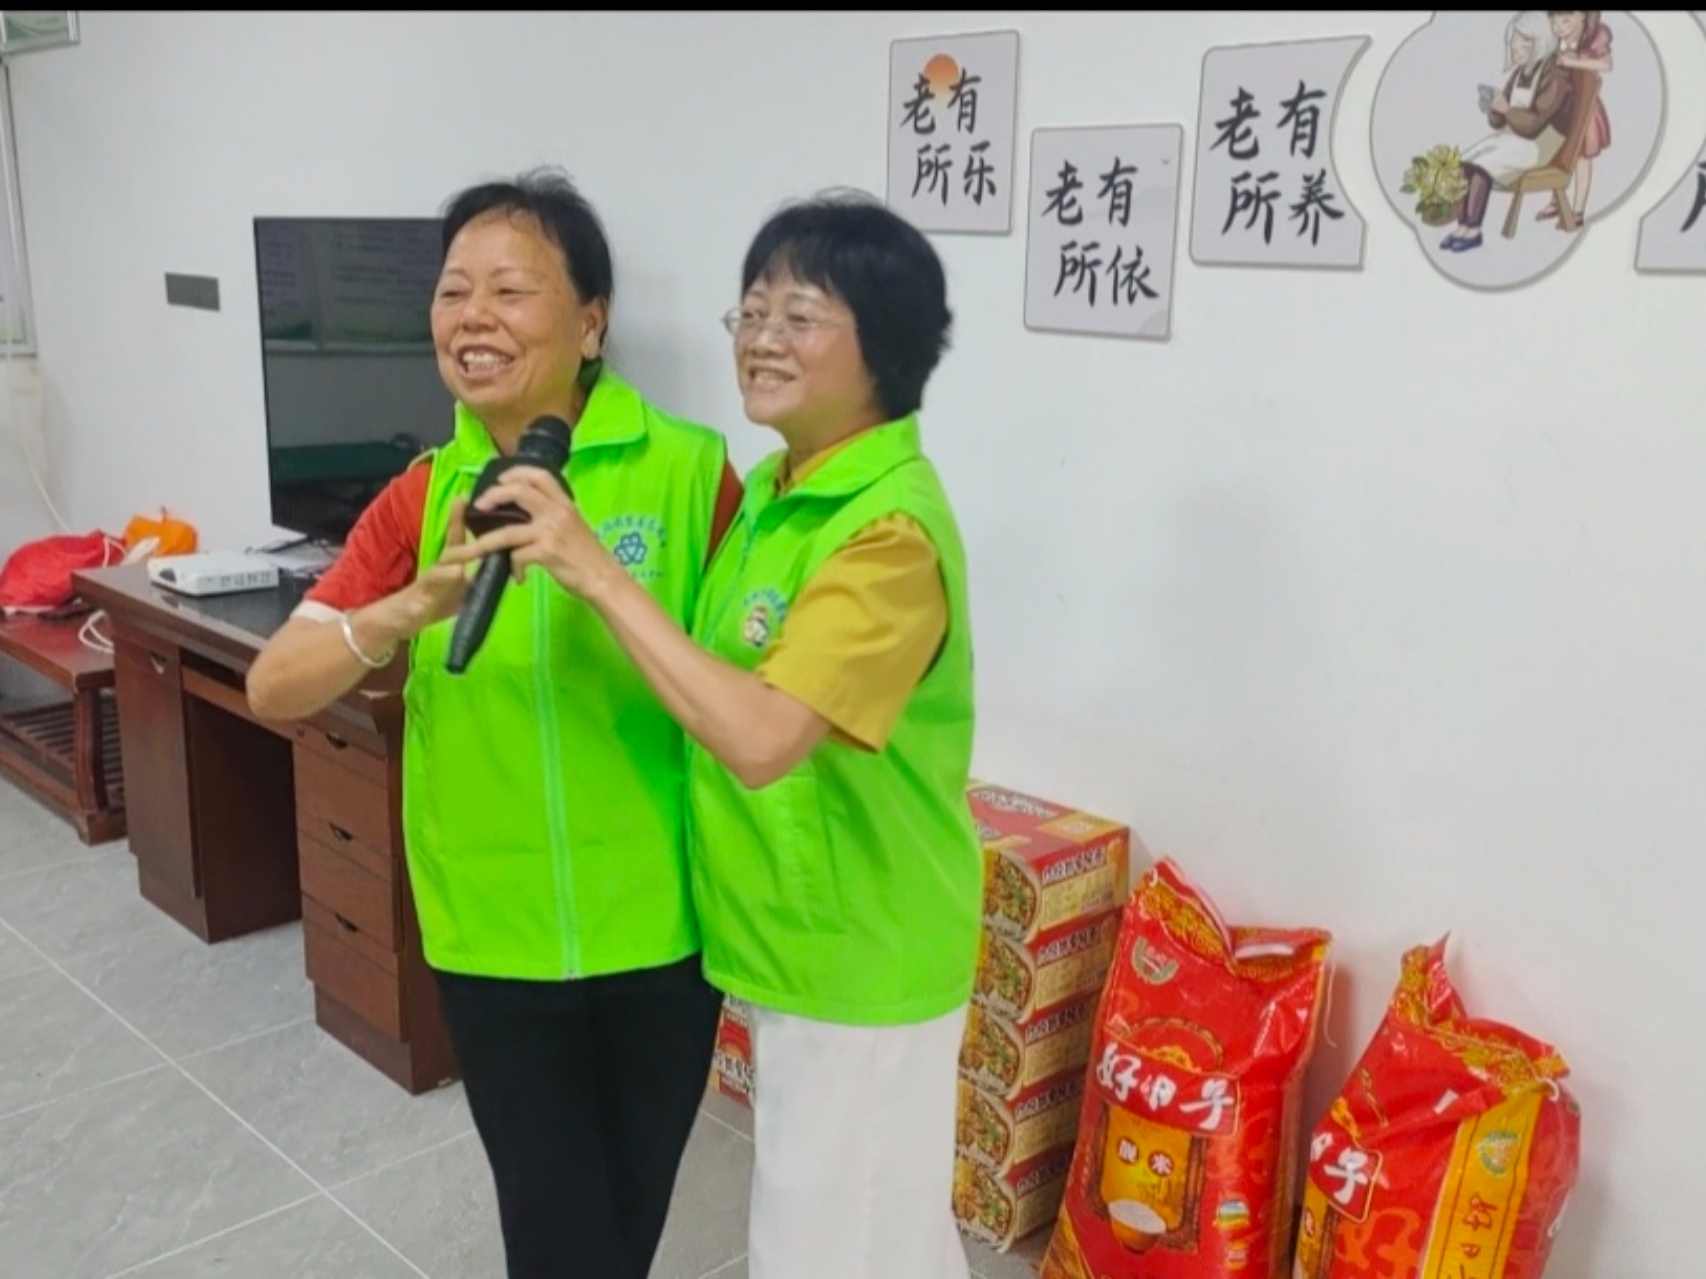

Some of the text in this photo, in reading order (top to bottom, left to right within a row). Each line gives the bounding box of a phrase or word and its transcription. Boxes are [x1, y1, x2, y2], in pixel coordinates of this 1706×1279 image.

[900, 68, 981, 135] 老有
[1210, 81, 1327, 160] 老有
[912, 142, 997, 205] 所乐
[1042, 157, 1137, 227] 老有
[1222, 169, 1345, 246] 所养
[1054, 241, 1159, 307] 所依
